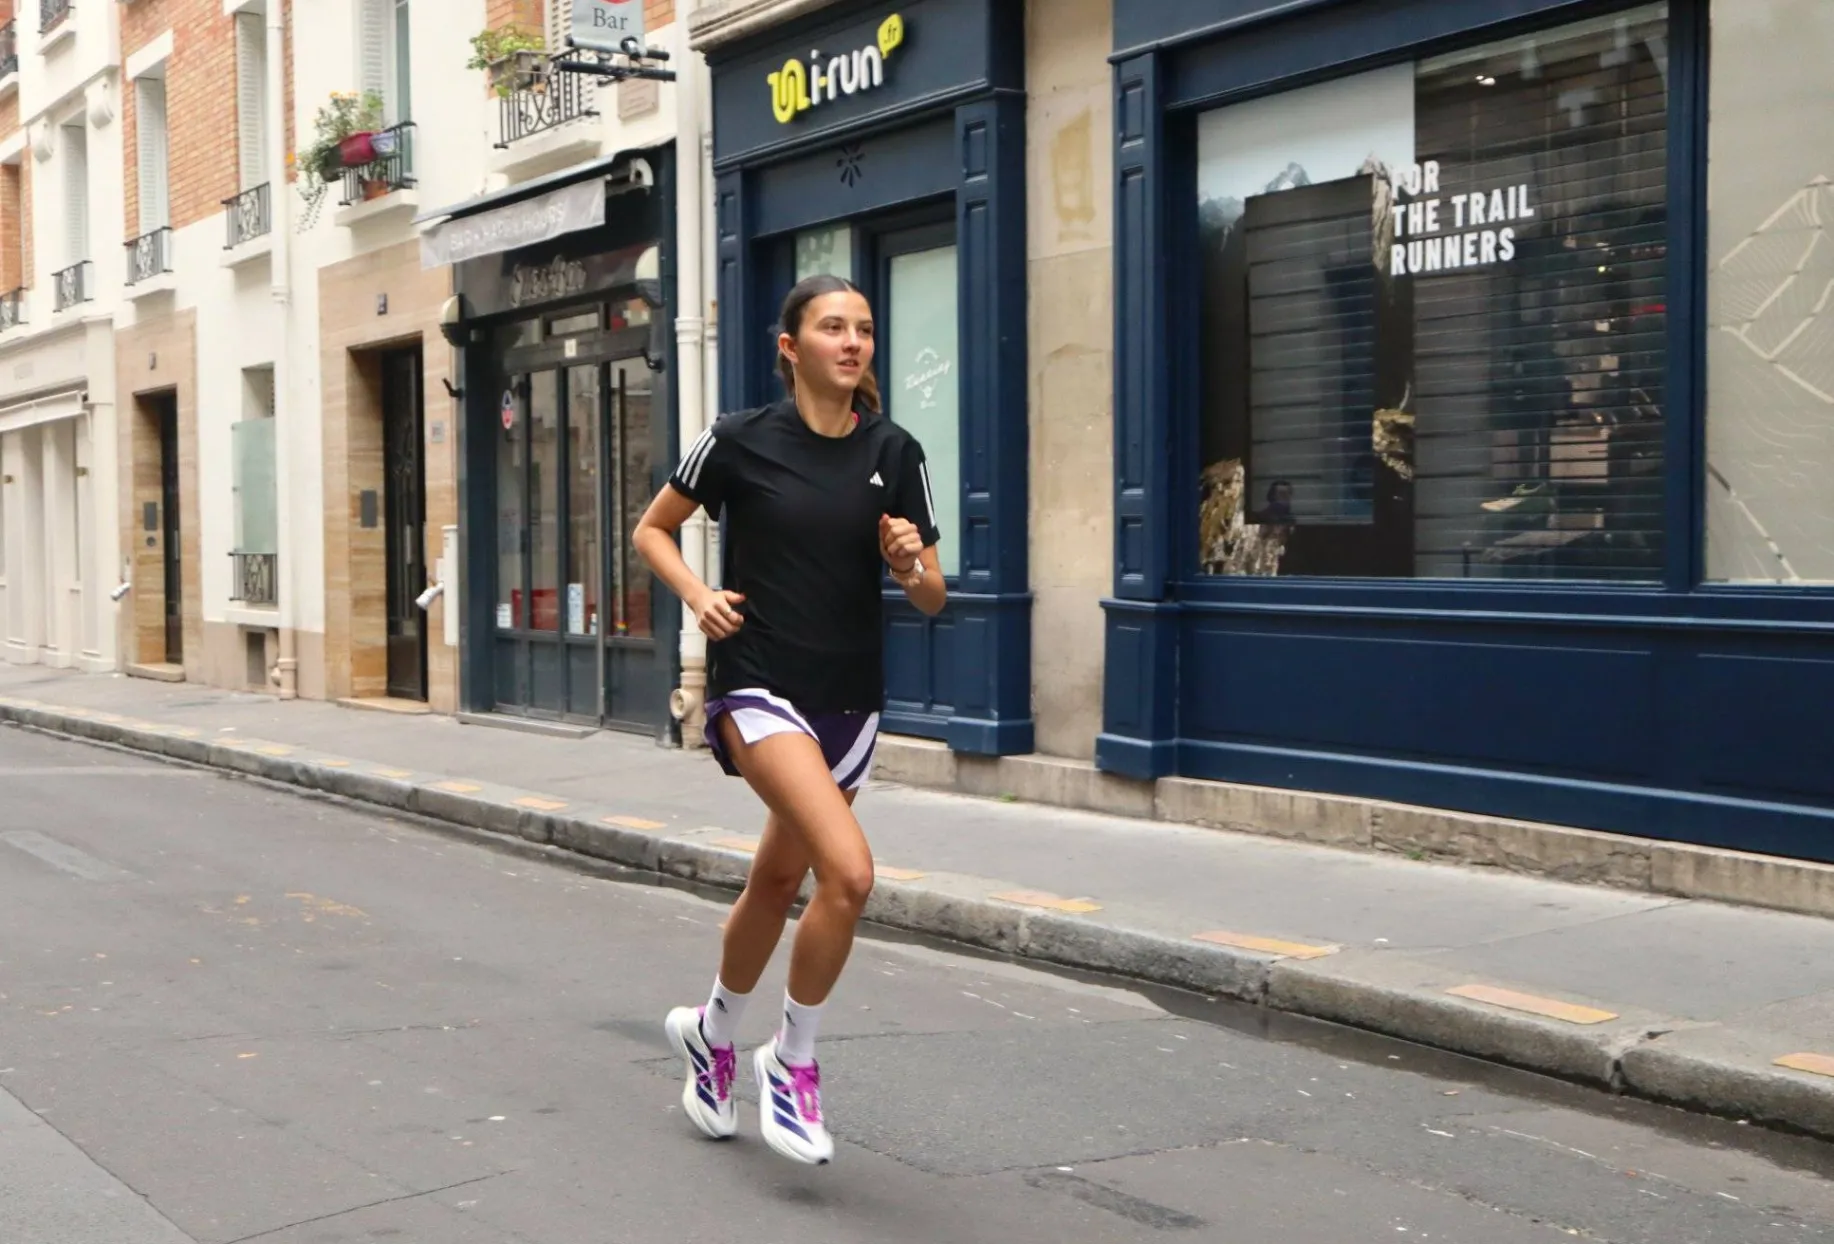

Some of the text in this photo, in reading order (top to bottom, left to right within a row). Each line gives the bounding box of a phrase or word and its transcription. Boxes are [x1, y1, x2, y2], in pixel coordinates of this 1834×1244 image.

[593, 7, 628, 30] Bar
[811, 45, 883, 105] i-run
[1392, 184, 1534, 237] THE TRAIL
[1390, 227, 1515, 276] RUNNERS
